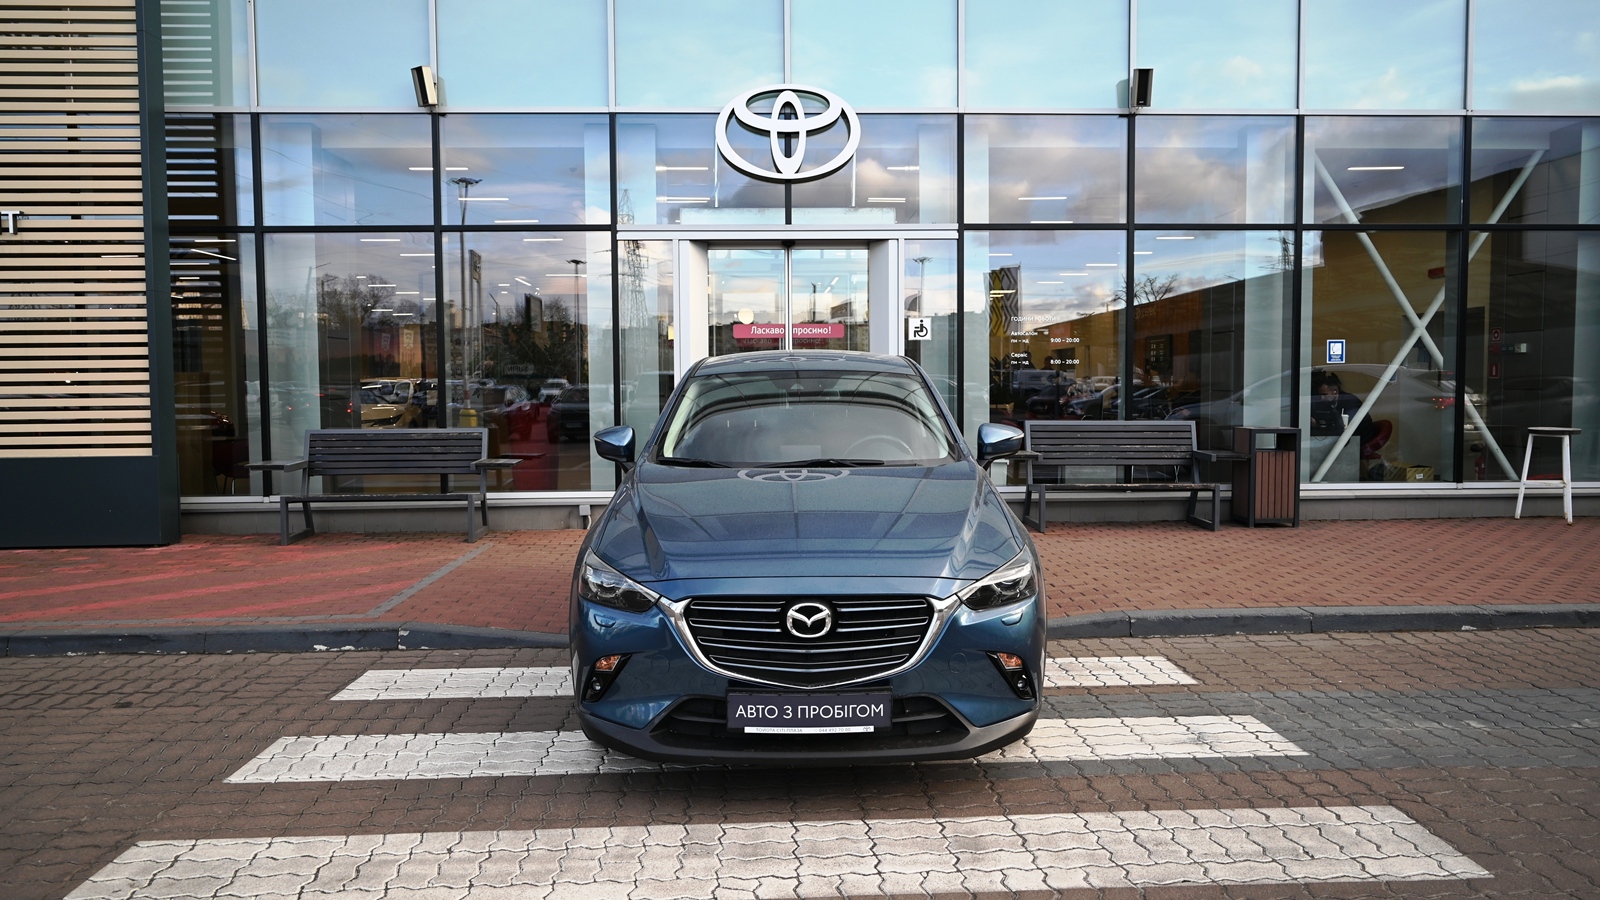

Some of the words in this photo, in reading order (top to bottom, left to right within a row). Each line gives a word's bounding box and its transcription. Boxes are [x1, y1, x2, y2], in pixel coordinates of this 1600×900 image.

[750, 325, 785, 335] Ласкаво
[792, 325, 832, 336] просимо!
[735, 704, 779, 719] АВТО
[782, 705, 793, 719] З
[797, 703, 884, 719] ПРОБІГОМ
